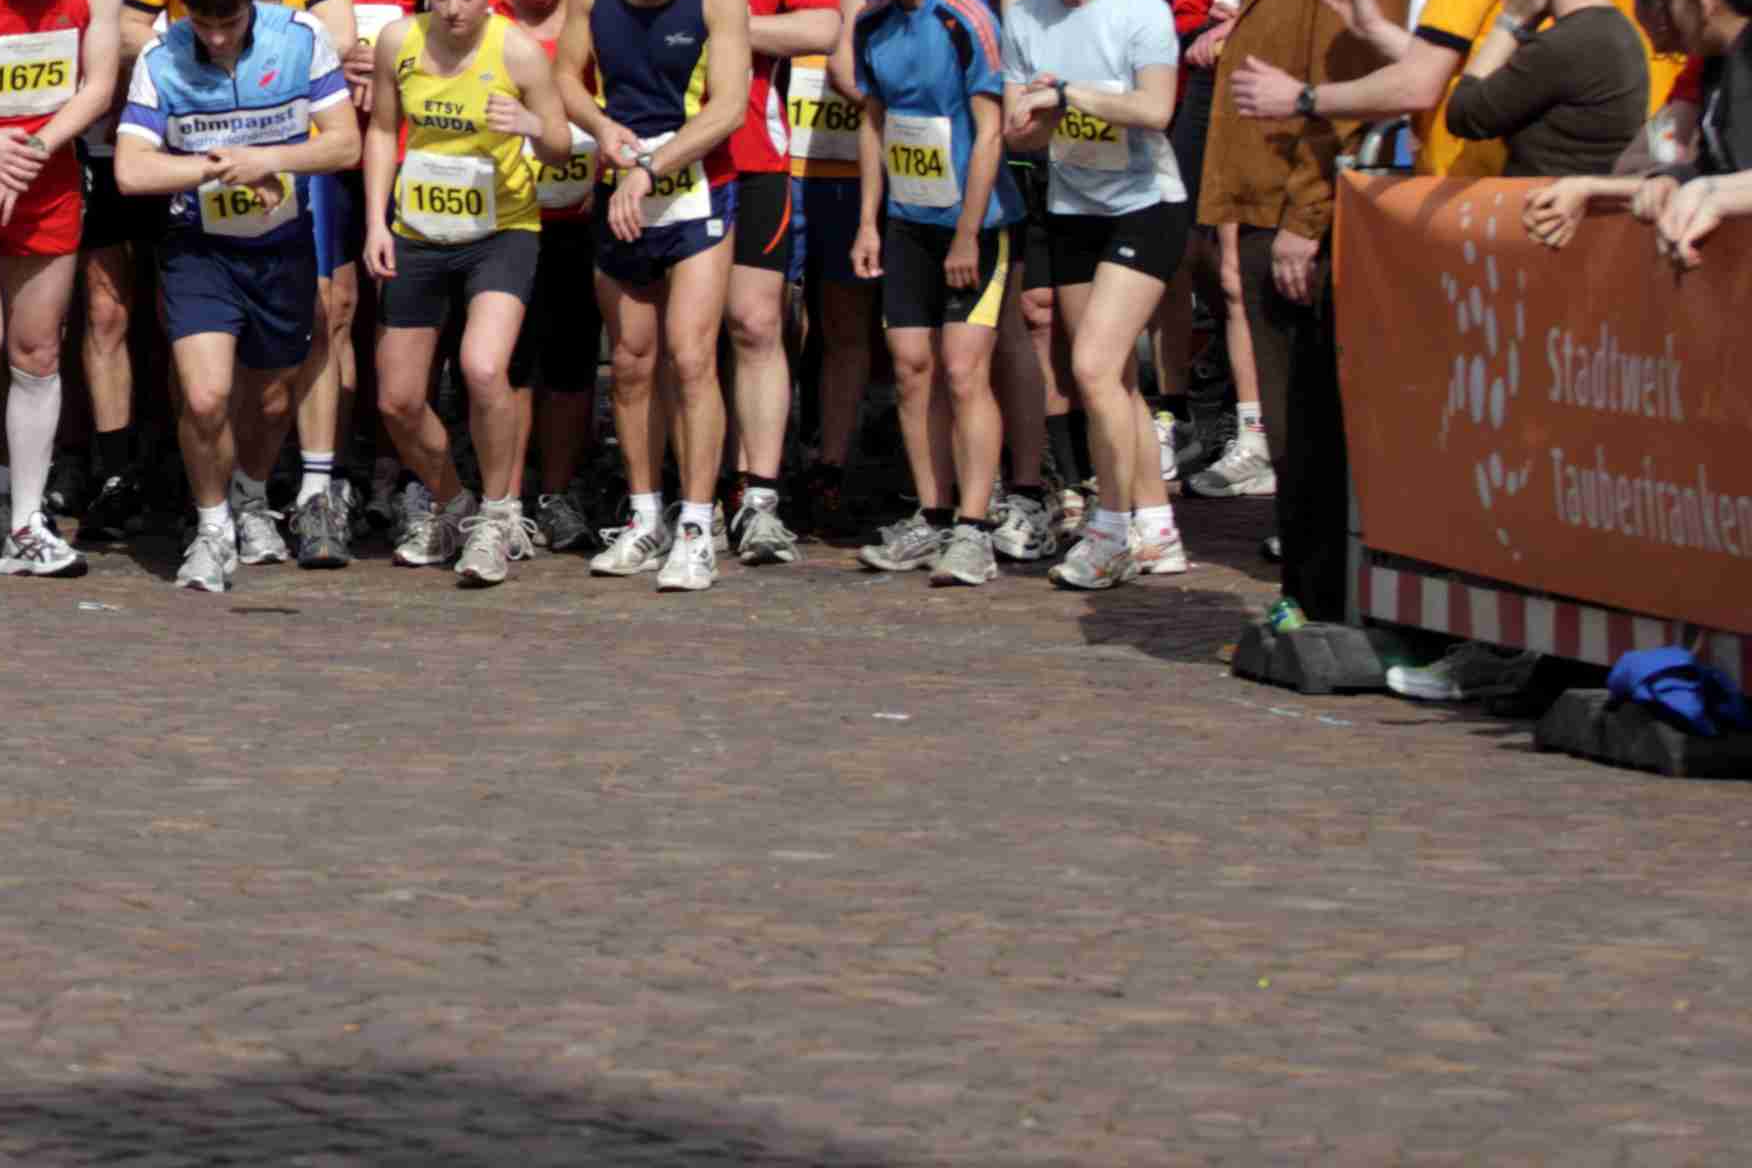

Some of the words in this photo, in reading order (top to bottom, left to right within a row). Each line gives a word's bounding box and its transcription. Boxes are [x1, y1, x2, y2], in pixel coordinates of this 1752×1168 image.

[179, 107, 295, 135] ebmpapst
[424, 100, 465, 115] ETSV
[410, 113, 478, 133] LAUDA
[890, 146, 943, 177] 1784
[412, 183, 483, 216] 1650
[1546, 320, 1688, 423] Stadtwerk
